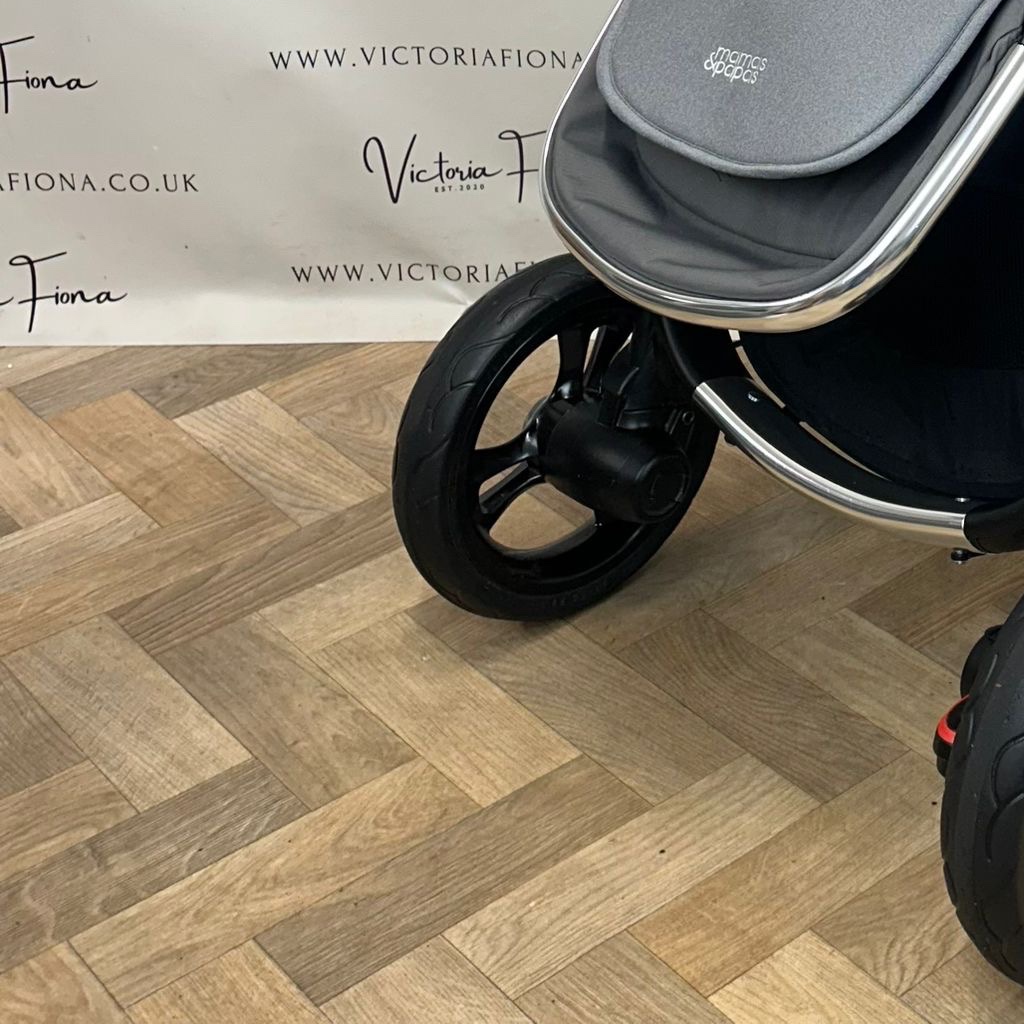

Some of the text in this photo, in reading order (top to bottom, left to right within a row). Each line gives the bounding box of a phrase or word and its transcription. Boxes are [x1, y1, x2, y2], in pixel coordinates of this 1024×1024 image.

[703, 52, 759, 84] &papas
[715, 46, 768, 71] mamas
[0, 173, 198, 192] FIONA.CO.UK
[363, 134, 503, 204] Victoria
[8, 251, 128, 333] Fiona
